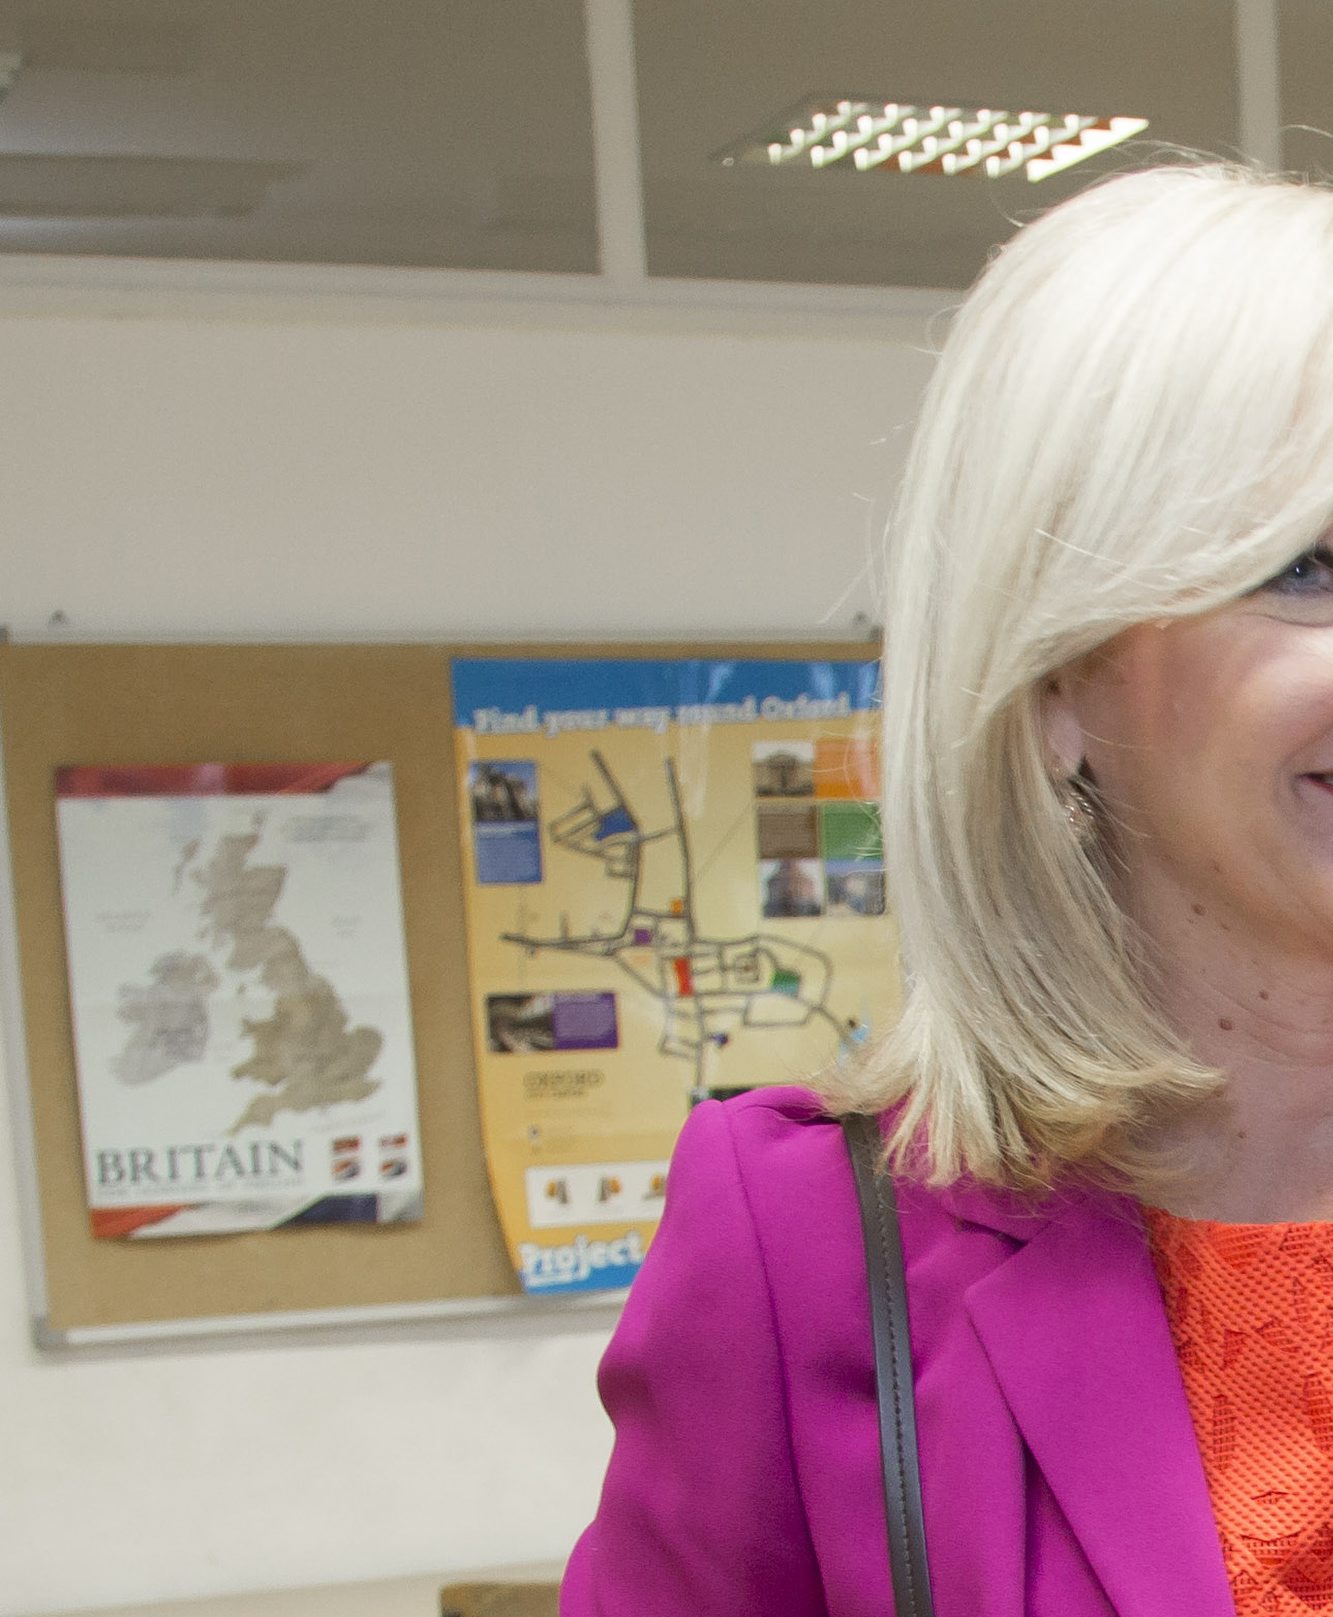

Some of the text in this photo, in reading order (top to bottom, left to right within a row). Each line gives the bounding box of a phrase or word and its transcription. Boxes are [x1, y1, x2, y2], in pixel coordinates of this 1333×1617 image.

[474, 704, 540, 735] Find
[543, 708, 608, 739] your
[612, 705, 671, 735] way
[760, 692, 852, 722] Oxford
[96, 1138, 305, 1184] BRITAIN
[519, 1231, 643, 1281] Project
